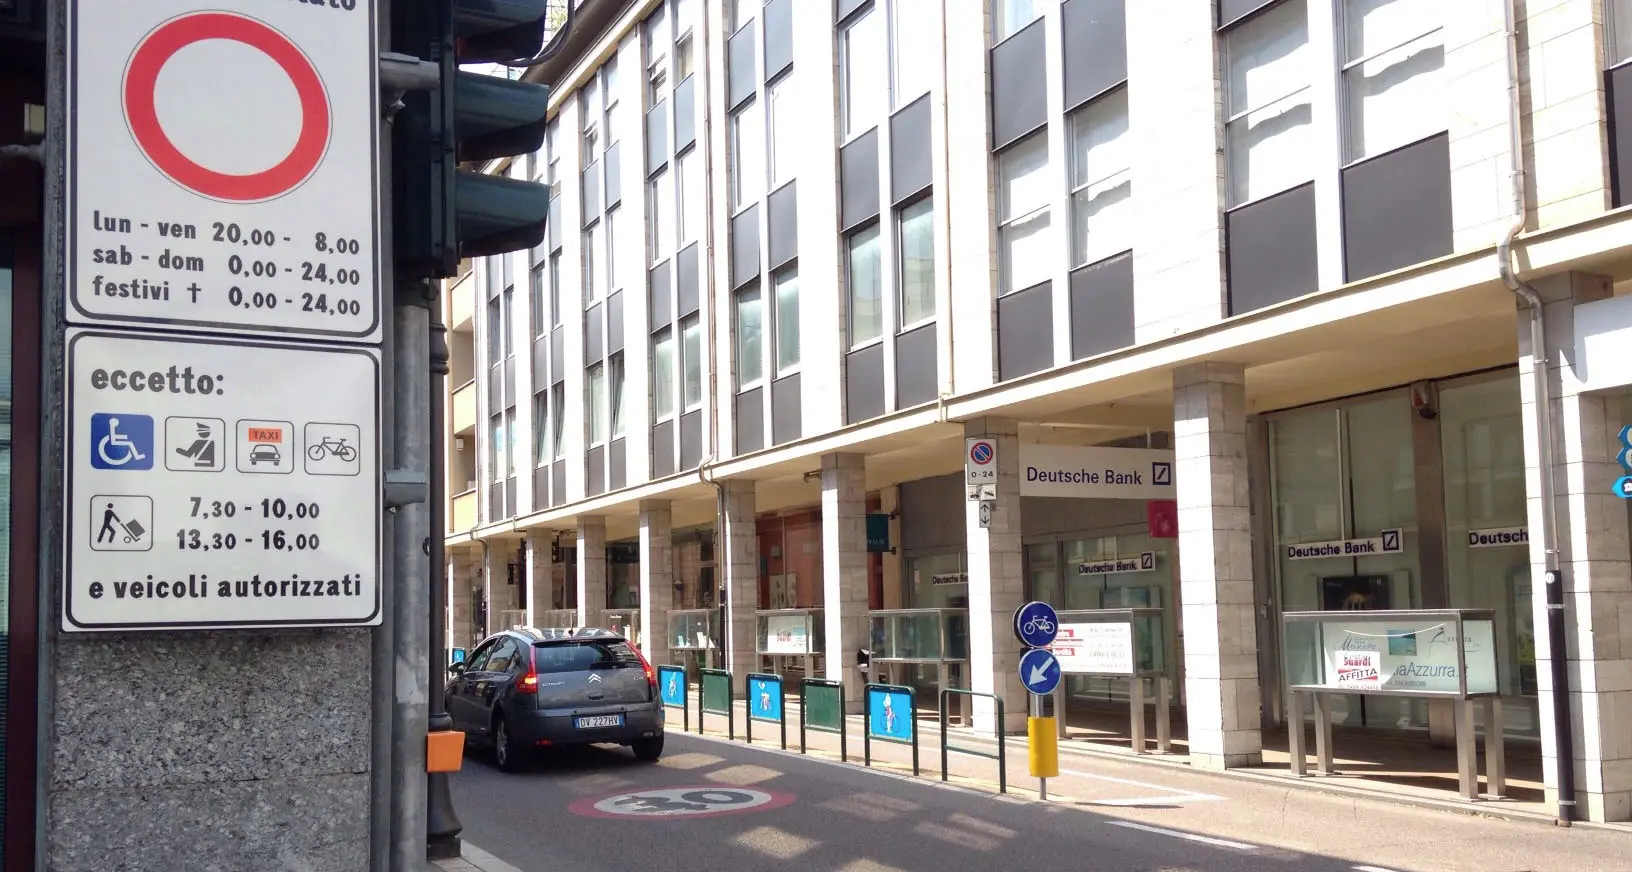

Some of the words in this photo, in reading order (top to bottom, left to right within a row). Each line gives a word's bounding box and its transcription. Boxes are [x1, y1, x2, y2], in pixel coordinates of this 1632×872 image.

[94, 210, 130, 233] lun
[158, 222, 195, 239] ven
[213, 222, 275, 247] 20,00
[315, 232, 359, 255] 8,00
[93, 245, 132, 266] sab
[159, 249, 203, 271] dom
[228, 255, 276, 278] 0,00
[302, 262, 359, 285] 24,00
[93, 276, 169, 301] festivi
[229, 286, 276, 309] 0,00
[302, 293, 360, 316] 24,00
[91, 366, 223, 396] eccetto:
[254, 431, 279, 440] TAXI
[1027, 466, 1099, 483] Deutsche
[1105, 470, 1142, 486] Bank
[191, 497, 235, 519] 7,30
[261, 498, 319, 520] 10,00
[177, 529, 236, 551] 13,30
[262, 530, 319, 552] 16,00
[1288, 544, 1340, 557] Deutsche
[1345, 541, 1374, 553] Bank
[1079, 563, 1114, 574] Deutsche
[1116, 560, 1137, 571] Bank
[89, 582, 103, 599] e
[114, 574, 207, 599] veicoli
[218, 574, 360, 598] autorizzati
[932, 575, 958, 585] Deutsche
[1338, 667, 1378, 682] AFFITTA
